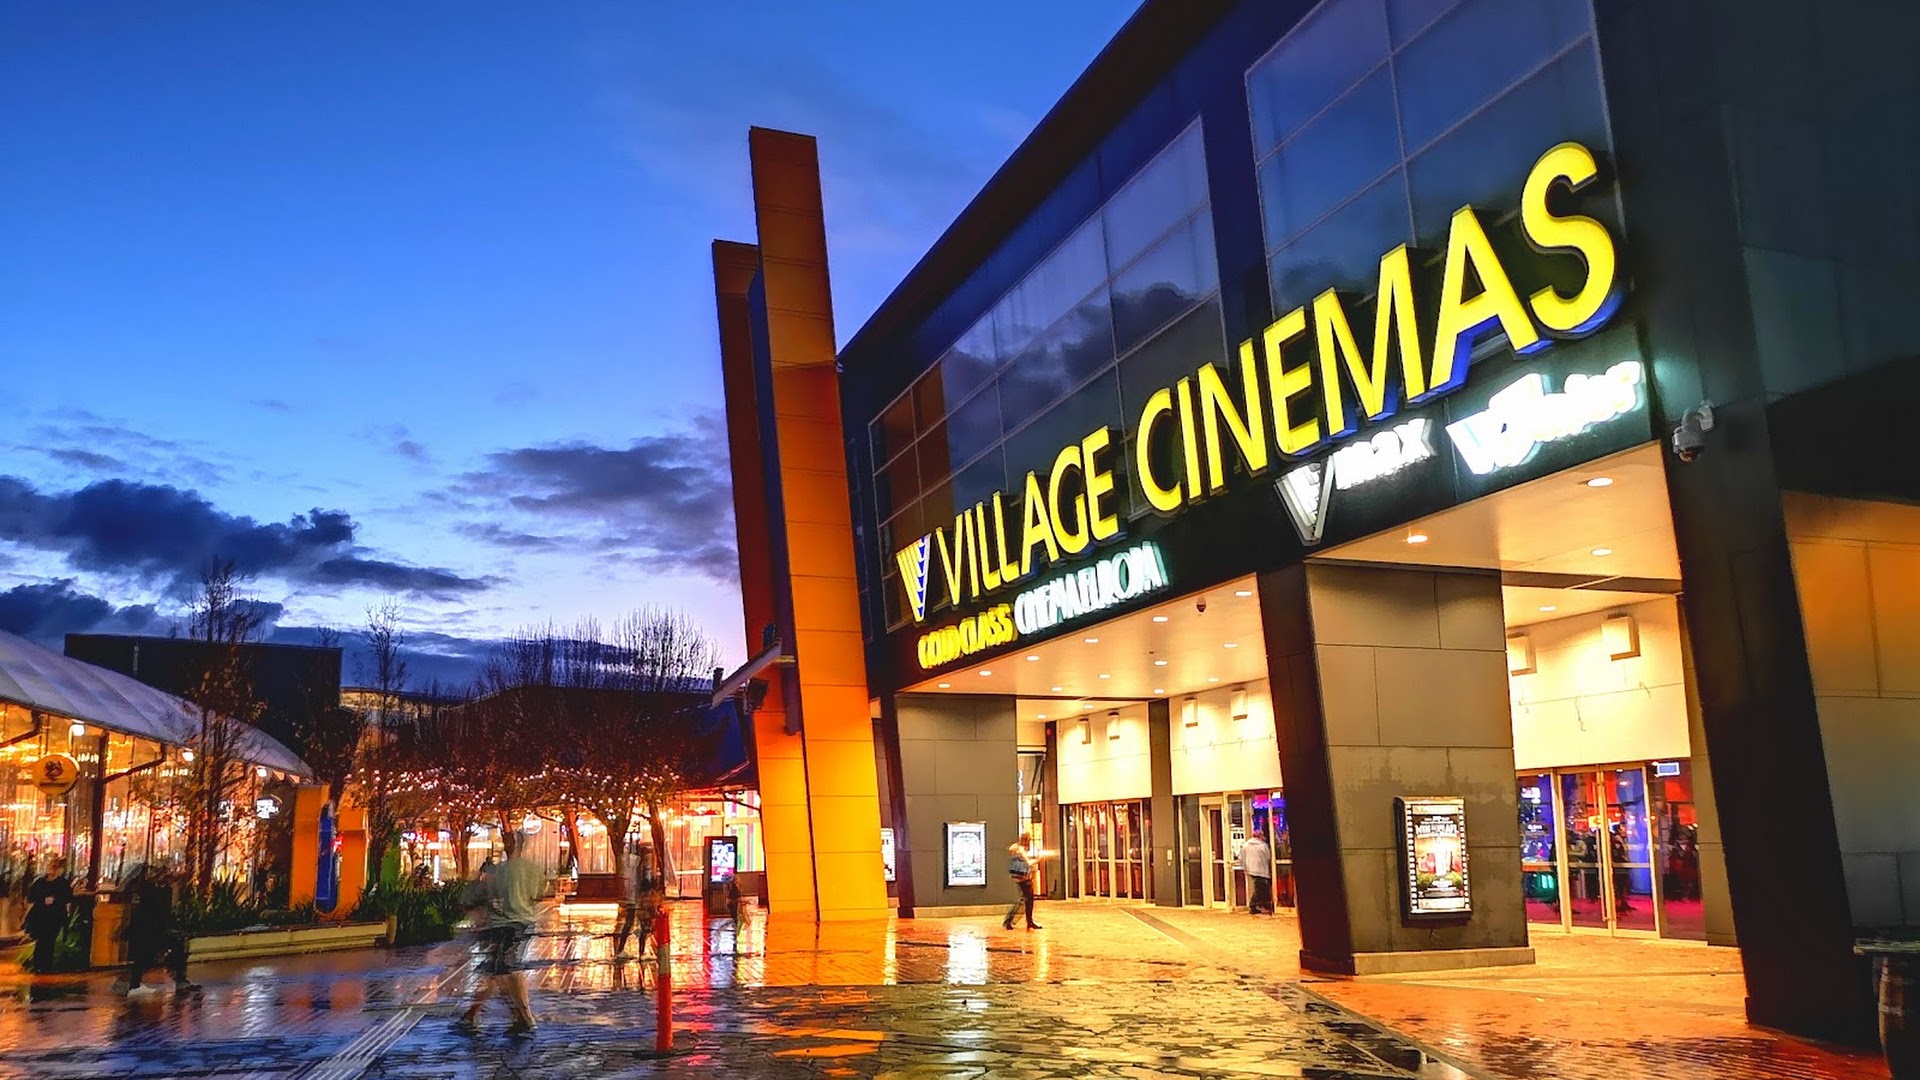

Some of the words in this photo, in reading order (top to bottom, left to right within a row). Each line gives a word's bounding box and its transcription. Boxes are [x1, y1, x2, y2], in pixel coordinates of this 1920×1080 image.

[935, 425, 1119, 606] VILLAGE
[1136, 142, 1617, 513] CINEMAS
[918, 625, 961, 669] GOLD
[959, 603, 1015, 655] CLASS
[1014, 573, 1081, 635] CINEMA
